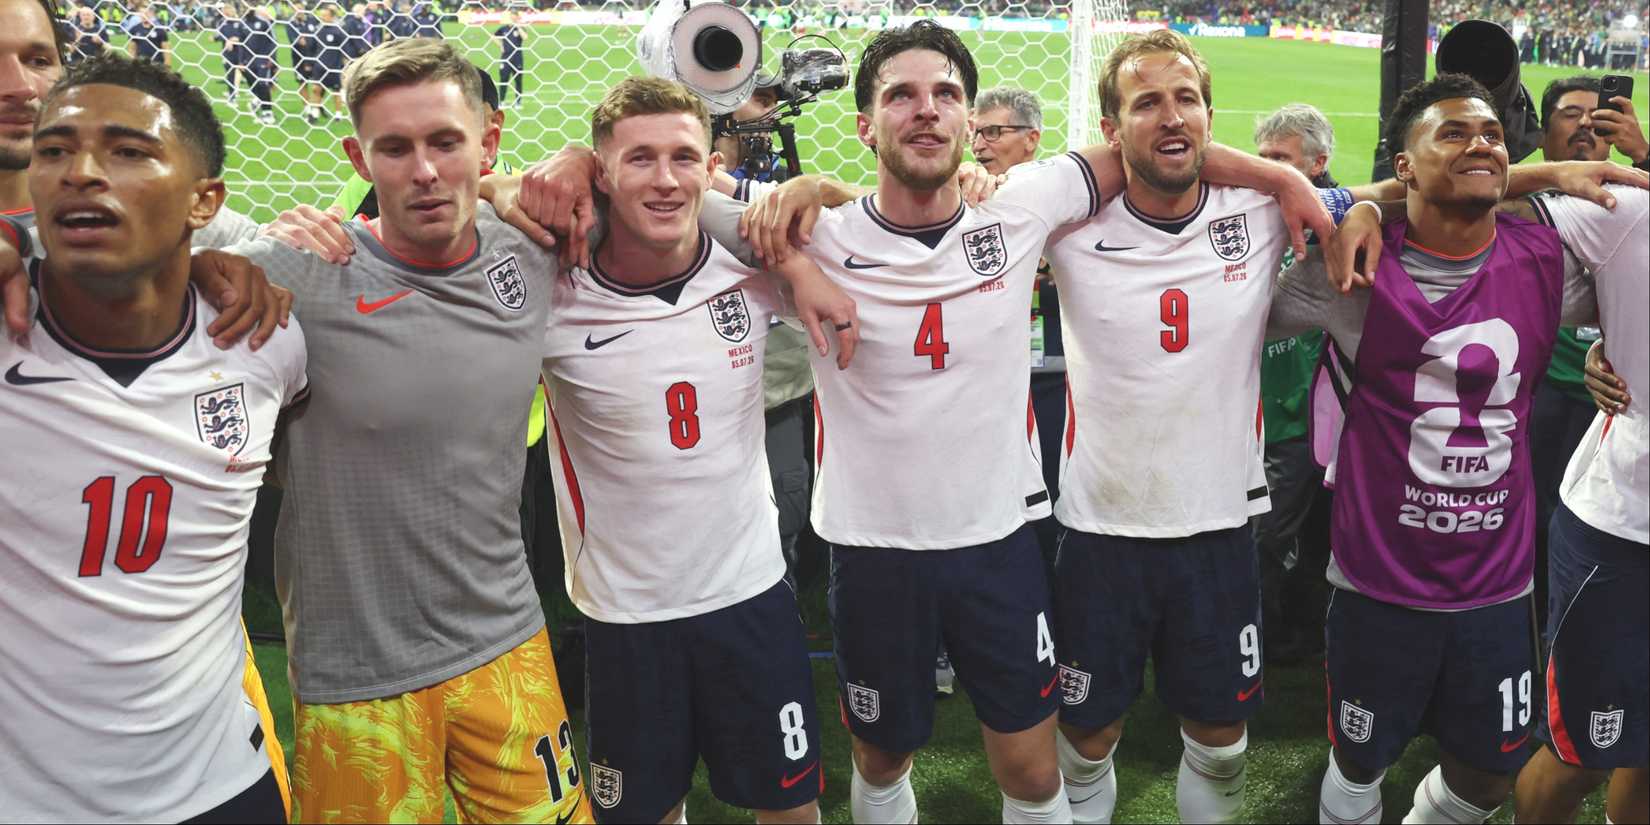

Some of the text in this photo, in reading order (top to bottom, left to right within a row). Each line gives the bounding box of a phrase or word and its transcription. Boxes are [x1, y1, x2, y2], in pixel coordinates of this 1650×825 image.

[914, 303, 949, 369] 4
[1160, 288, 1189, 353] 9
[728, 344, 753, 358] MEXICO
[665, 381, 701, 450] 8
[1440, 455, 1490, 473] FIFA
[78, 475, 173, 577] 10
[1398, 504, 1505, 534] 2026
[1404, 484, 1510, 508] WORLD CUP
[1036, 611, 1056, 667] 4
[1239, 624, 1261, 678] 9
[779, 701, 809, 761] 8
[1498, 670, 1532, 732] 19
[533, 718, 582, 805] 13
